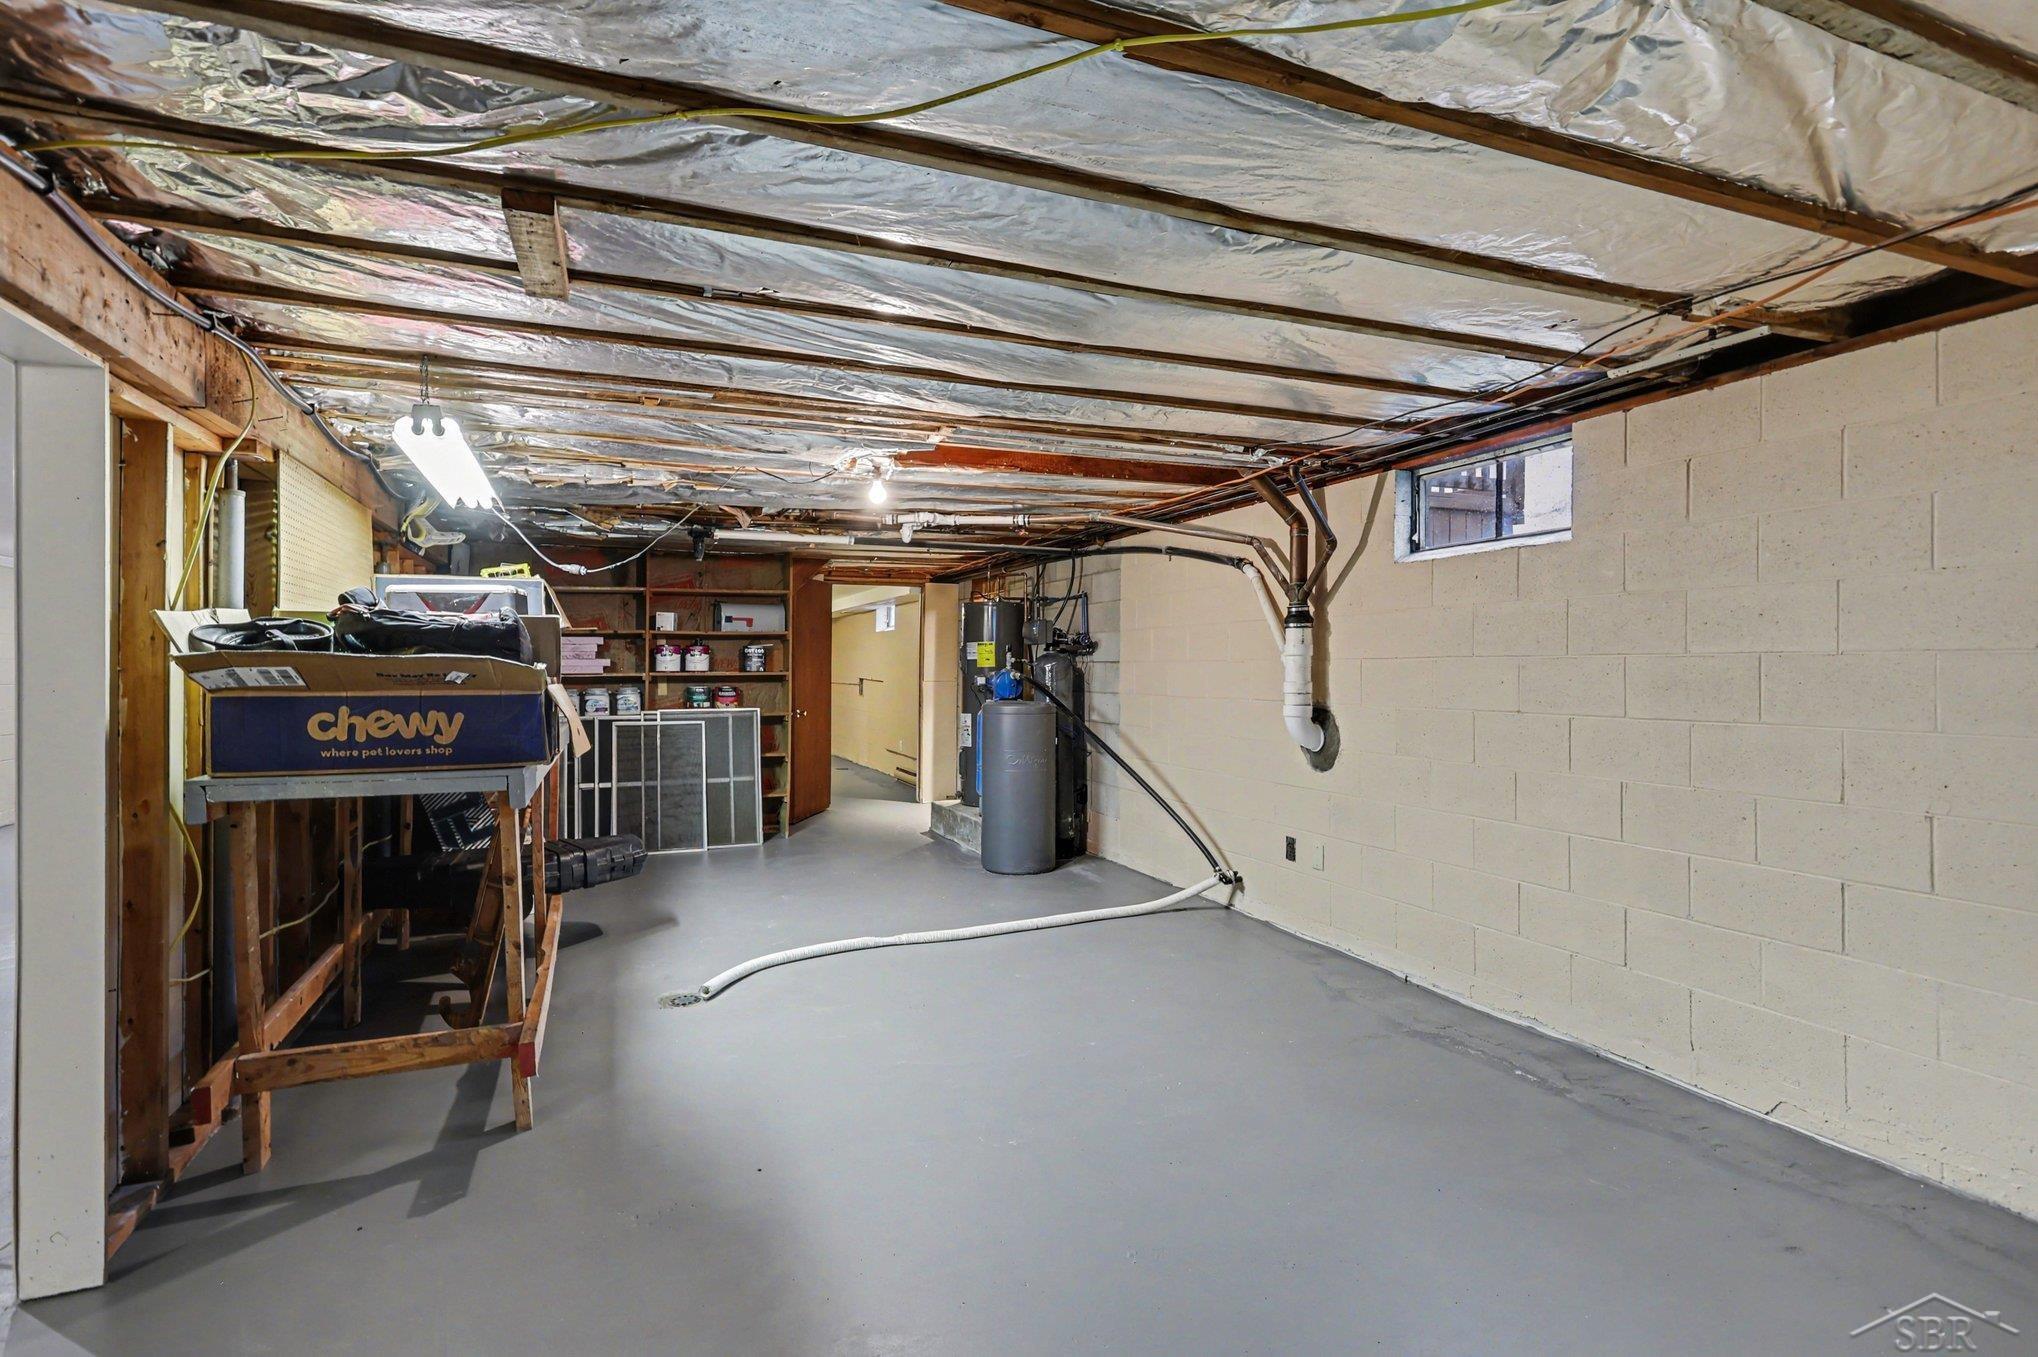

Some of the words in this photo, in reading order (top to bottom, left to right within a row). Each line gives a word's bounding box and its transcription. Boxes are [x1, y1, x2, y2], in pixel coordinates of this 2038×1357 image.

[307, 705, 464, 745] chewy
[320, 748, 358, 758] where
[362, 747, 383, 759] pet
[385, 746, 422, 756] lovers
[425, 745, 453, 756] shop
